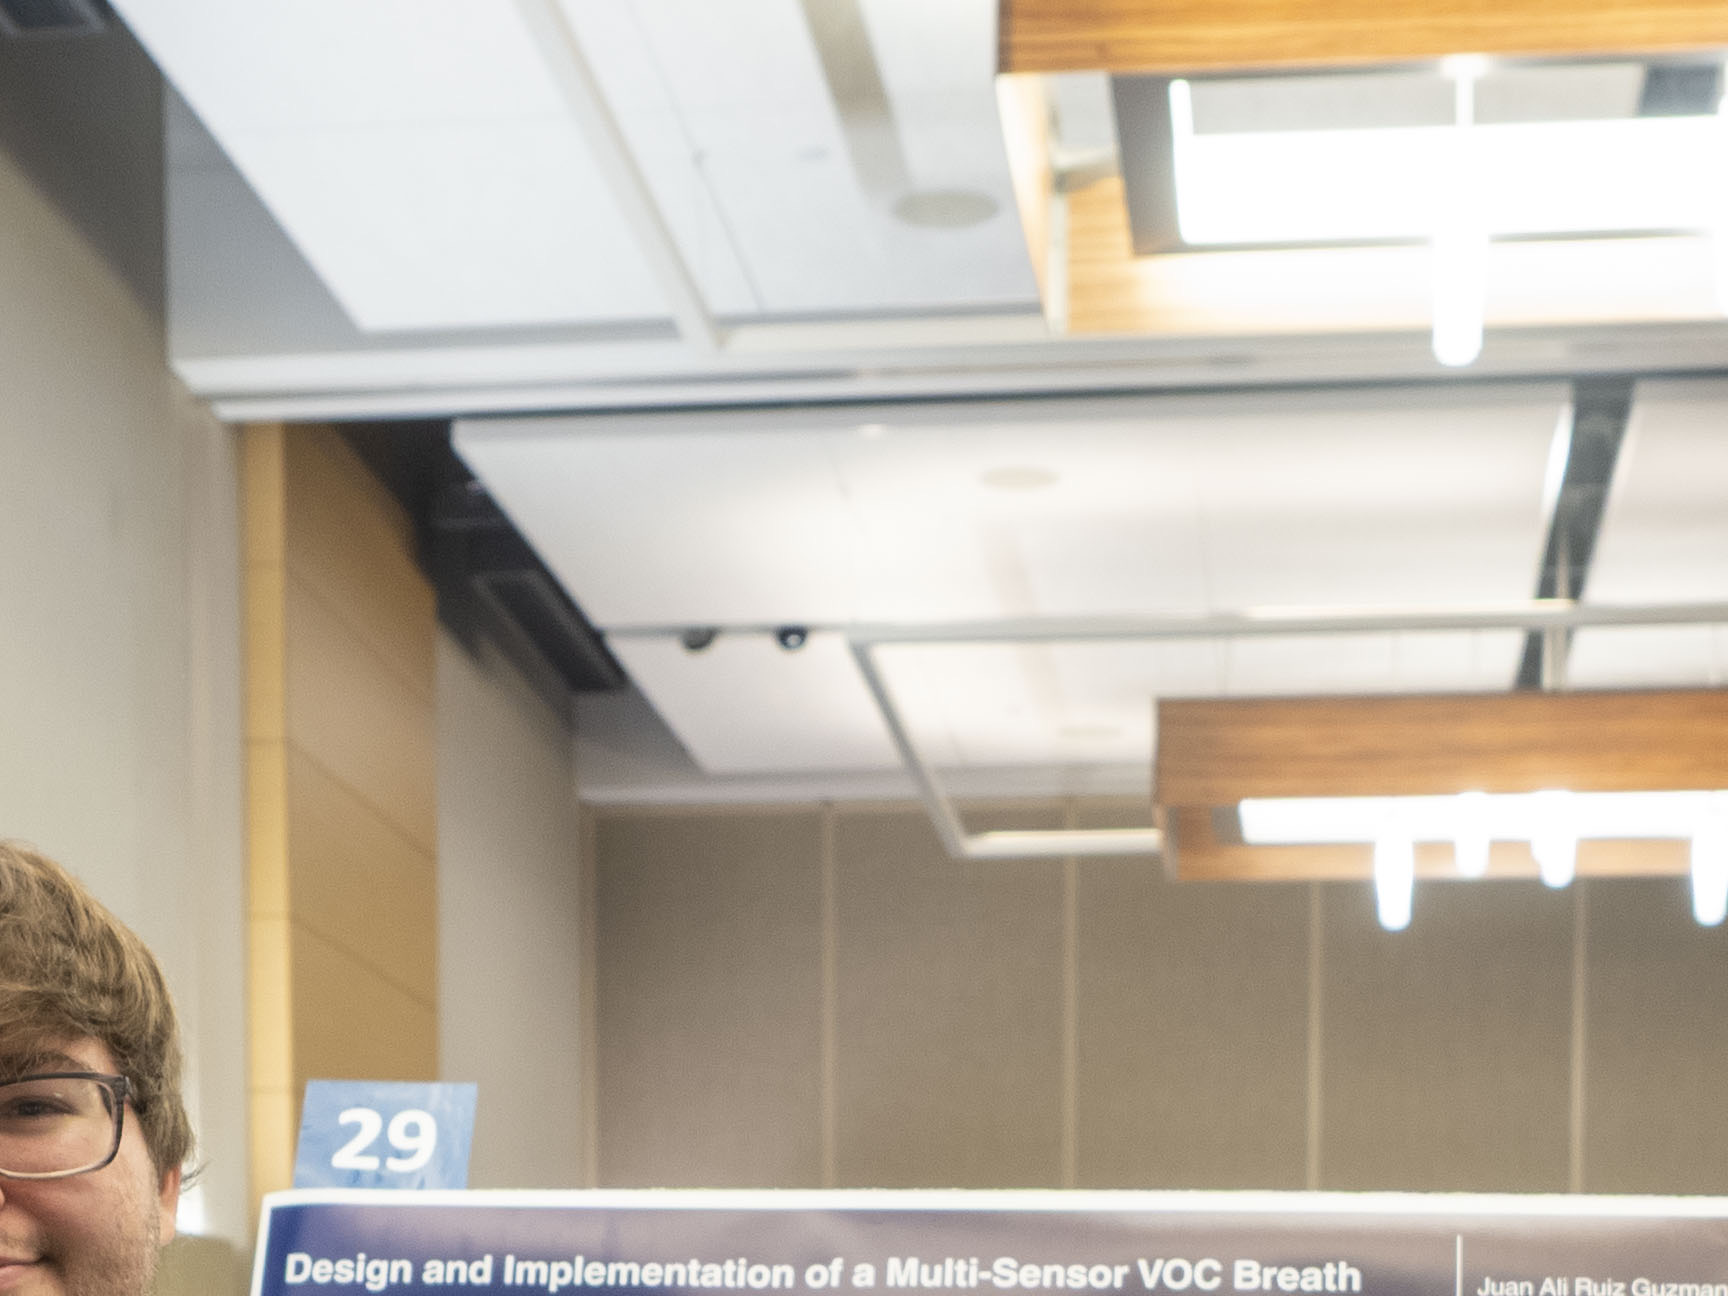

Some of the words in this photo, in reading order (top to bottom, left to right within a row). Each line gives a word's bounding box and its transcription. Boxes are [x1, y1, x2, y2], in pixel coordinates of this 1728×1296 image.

[331, 1107, 438, 1174] 29
[285, 1252, 413, 1292] Design
[421, 1253, 494, 1285] and
[503, 1253, 795, 1293] Implementation
[804, 1257, 844, 1289] of
[851, 1262, 876, 1288] a
[886, 1256, 1130, 1289] Multi-Sensor
[1137, 1257, 1223, 1291] VOC
[1233, 1258, 1362, 1292] Breath
